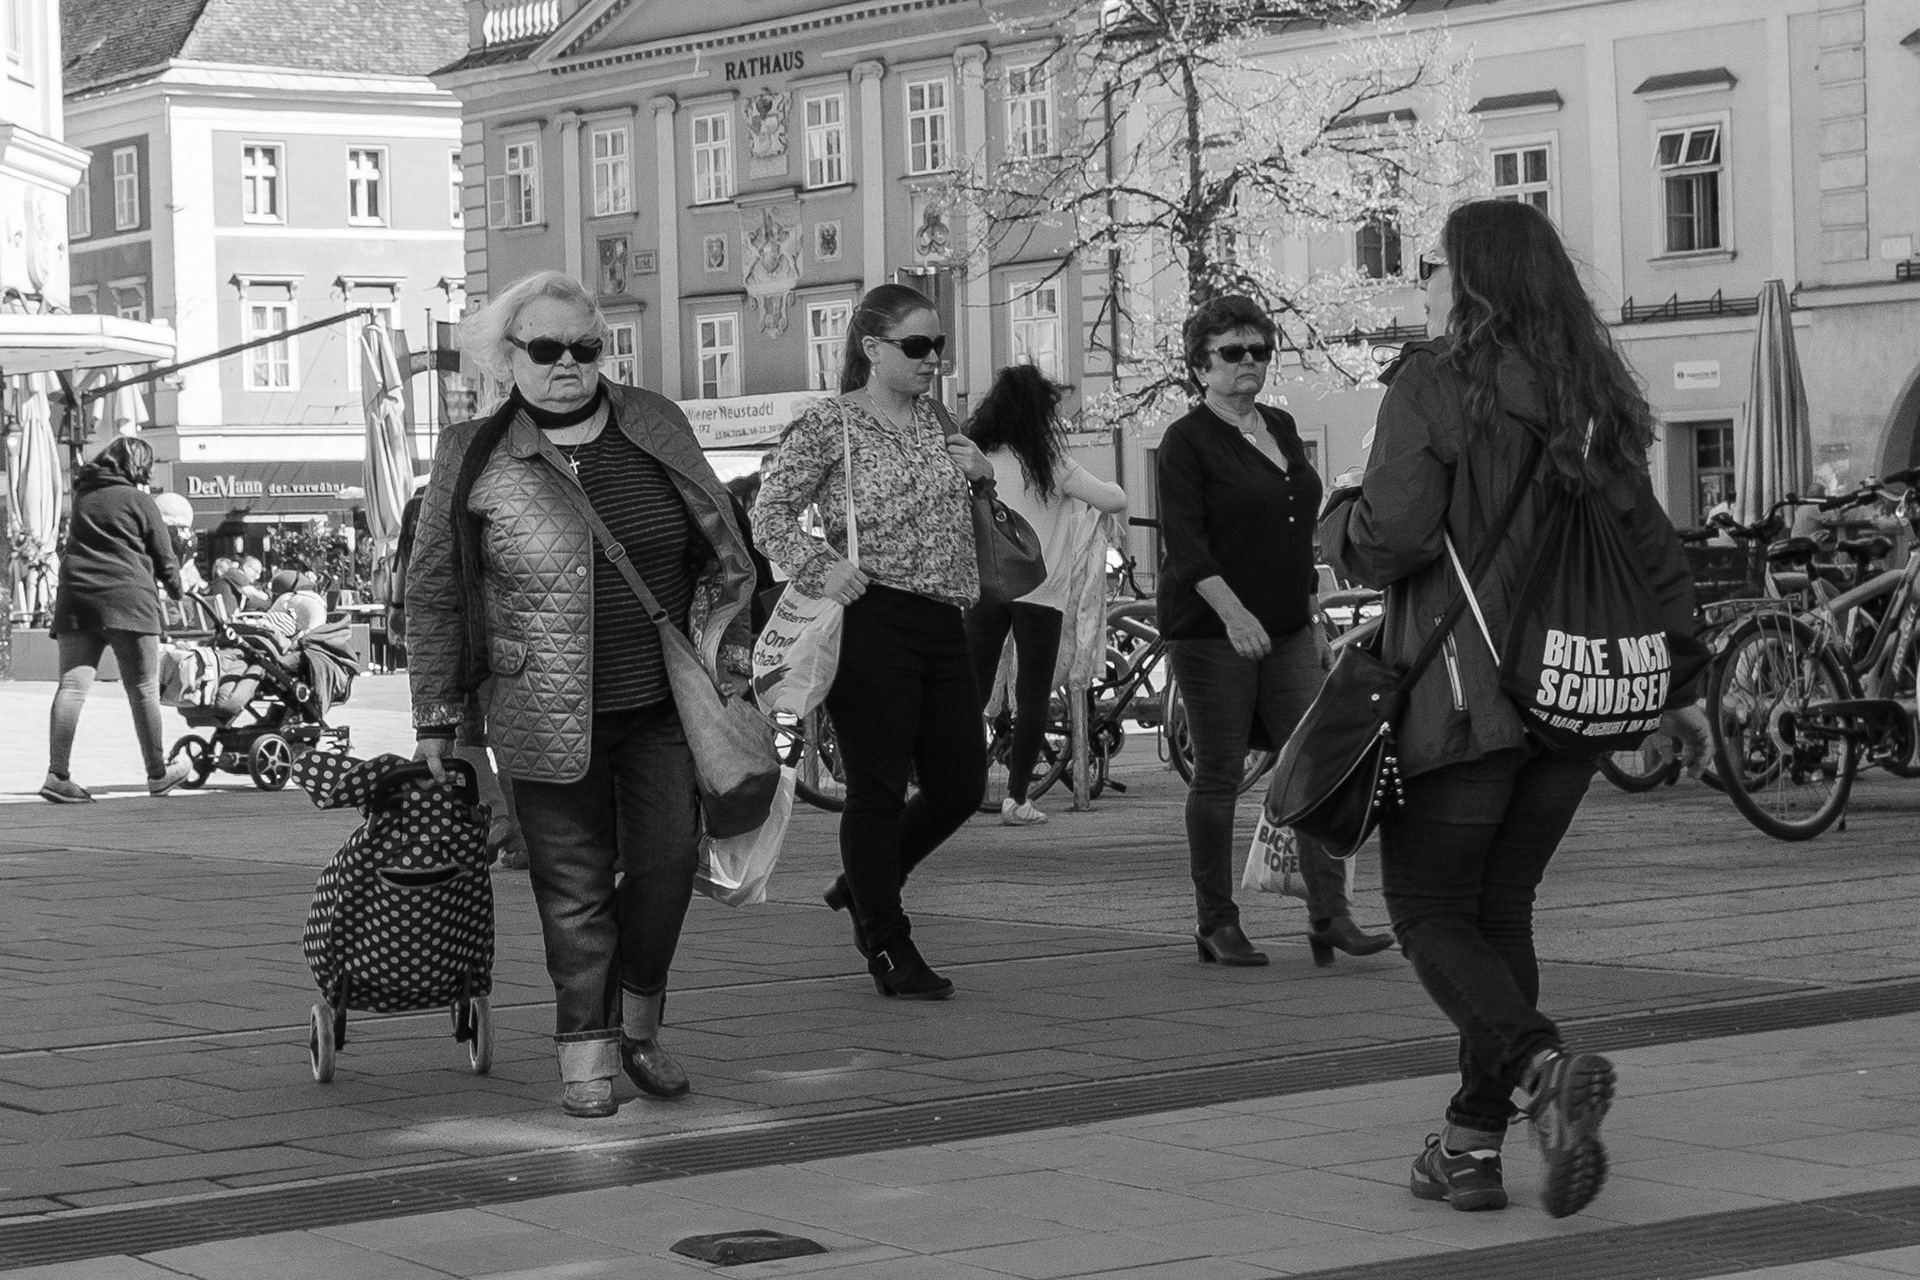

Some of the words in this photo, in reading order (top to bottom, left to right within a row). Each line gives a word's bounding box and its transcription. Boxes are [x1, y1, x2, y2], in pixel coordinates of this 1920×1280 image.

[725, 50, 804, 81] RATHAUS
[685, 406, 717, 422] Wiener
[718, 401, 774, 420] Neustadt!
[187, 475, 263, 498] DerMann
[269, 483, 288, 493] der
[1536, 668, 1671, 715] SCHUBSEN
[1550, 714, 1584, 733] HABE
[1626, 719, 1644, 733] IM
